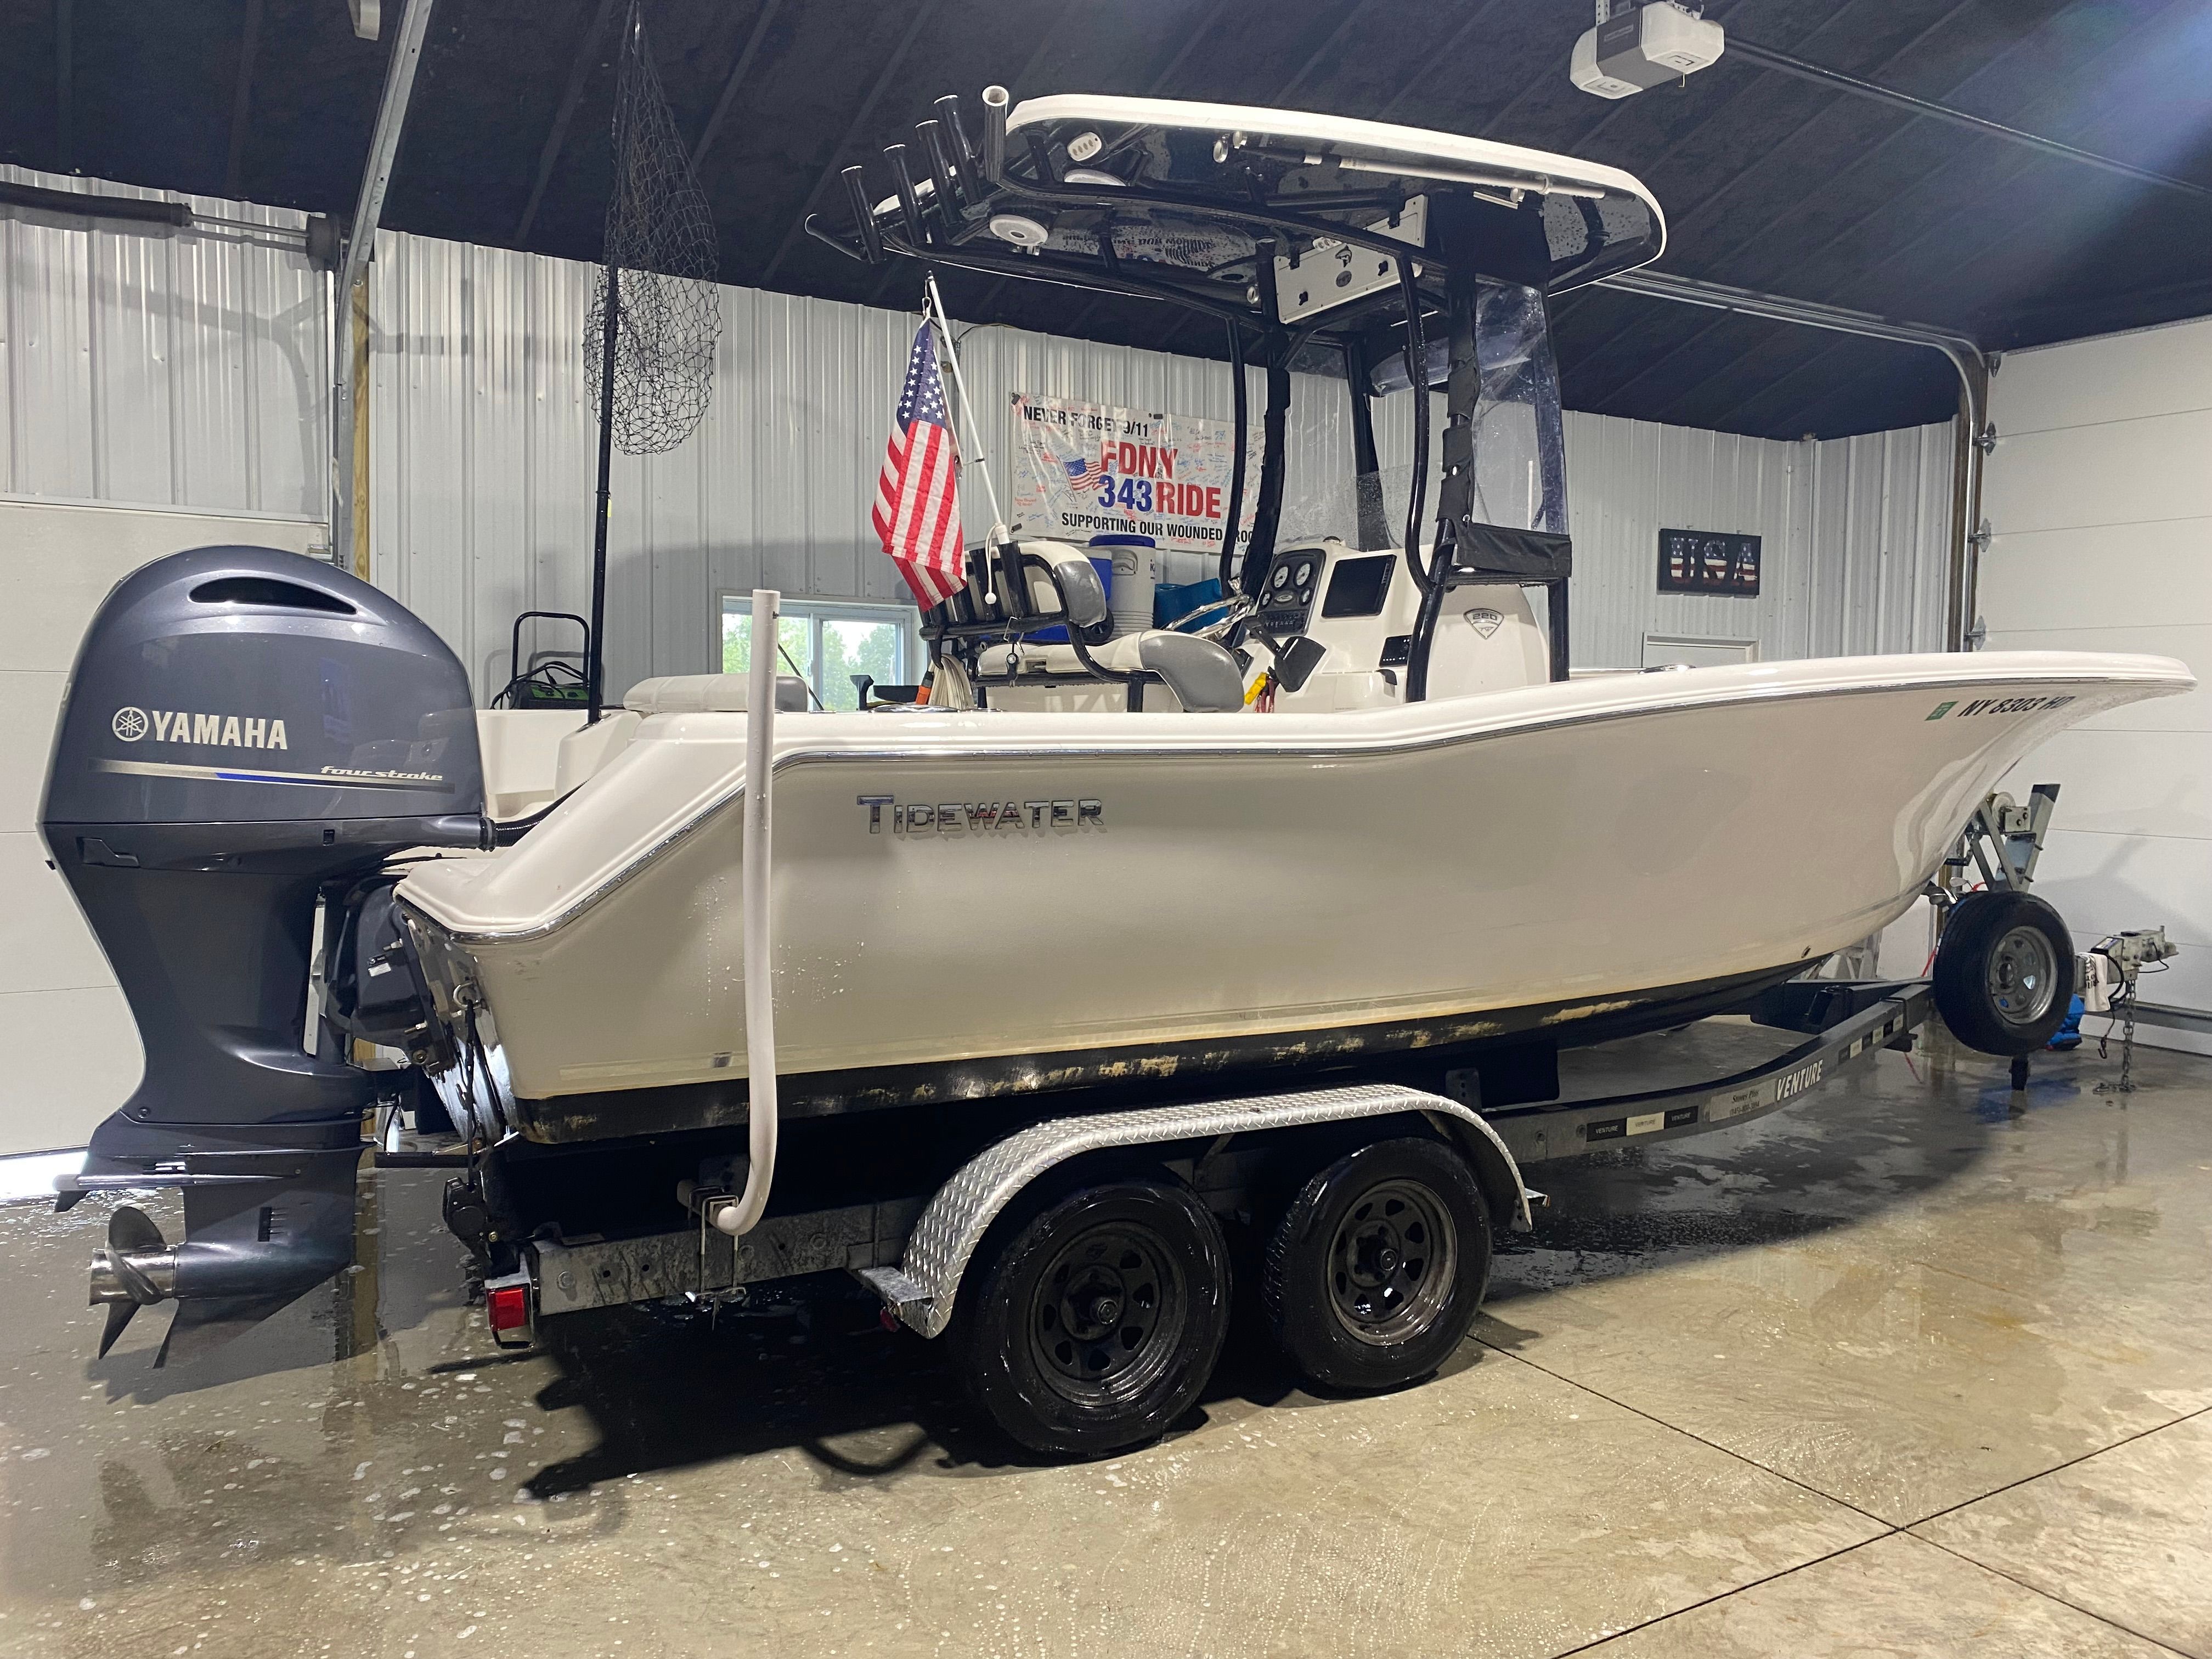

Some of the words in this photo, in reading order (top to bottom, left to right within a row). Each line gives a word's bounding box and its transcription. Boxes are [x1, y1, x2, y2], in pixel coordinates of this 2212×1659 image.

[1024, 405, 1066, 425] NEVER
[1070, 412, 1119, 432] FORGET
[1123, 420, 1148, 437] 9/11
[1101, 440, 1178, 479] FDNY
[1098, 474, 1153, 512] 343
[1155, 481, 1221, 518] RIDE
[1062, 512, 1136, 533] SUPPORTING
[1139, 521, 1163, 536] OUR
[1167, 523, 1223, 541] WOUNDED
[1472, 612, 1498, 621] 220
[1957, 698, 1999, 717] NY
[151, 710, 287, 750] YAMAHA
[857, 795, 1104, 834] TIDEWATER
[1776, 1059, 1824, 1102] VENTURE
[1595, 1125, 1618, 1135] VENTURE
[1635, 1119, 1656, 1128] VENTURE
[1671, 1111, 1691, 1121] VENTURE
